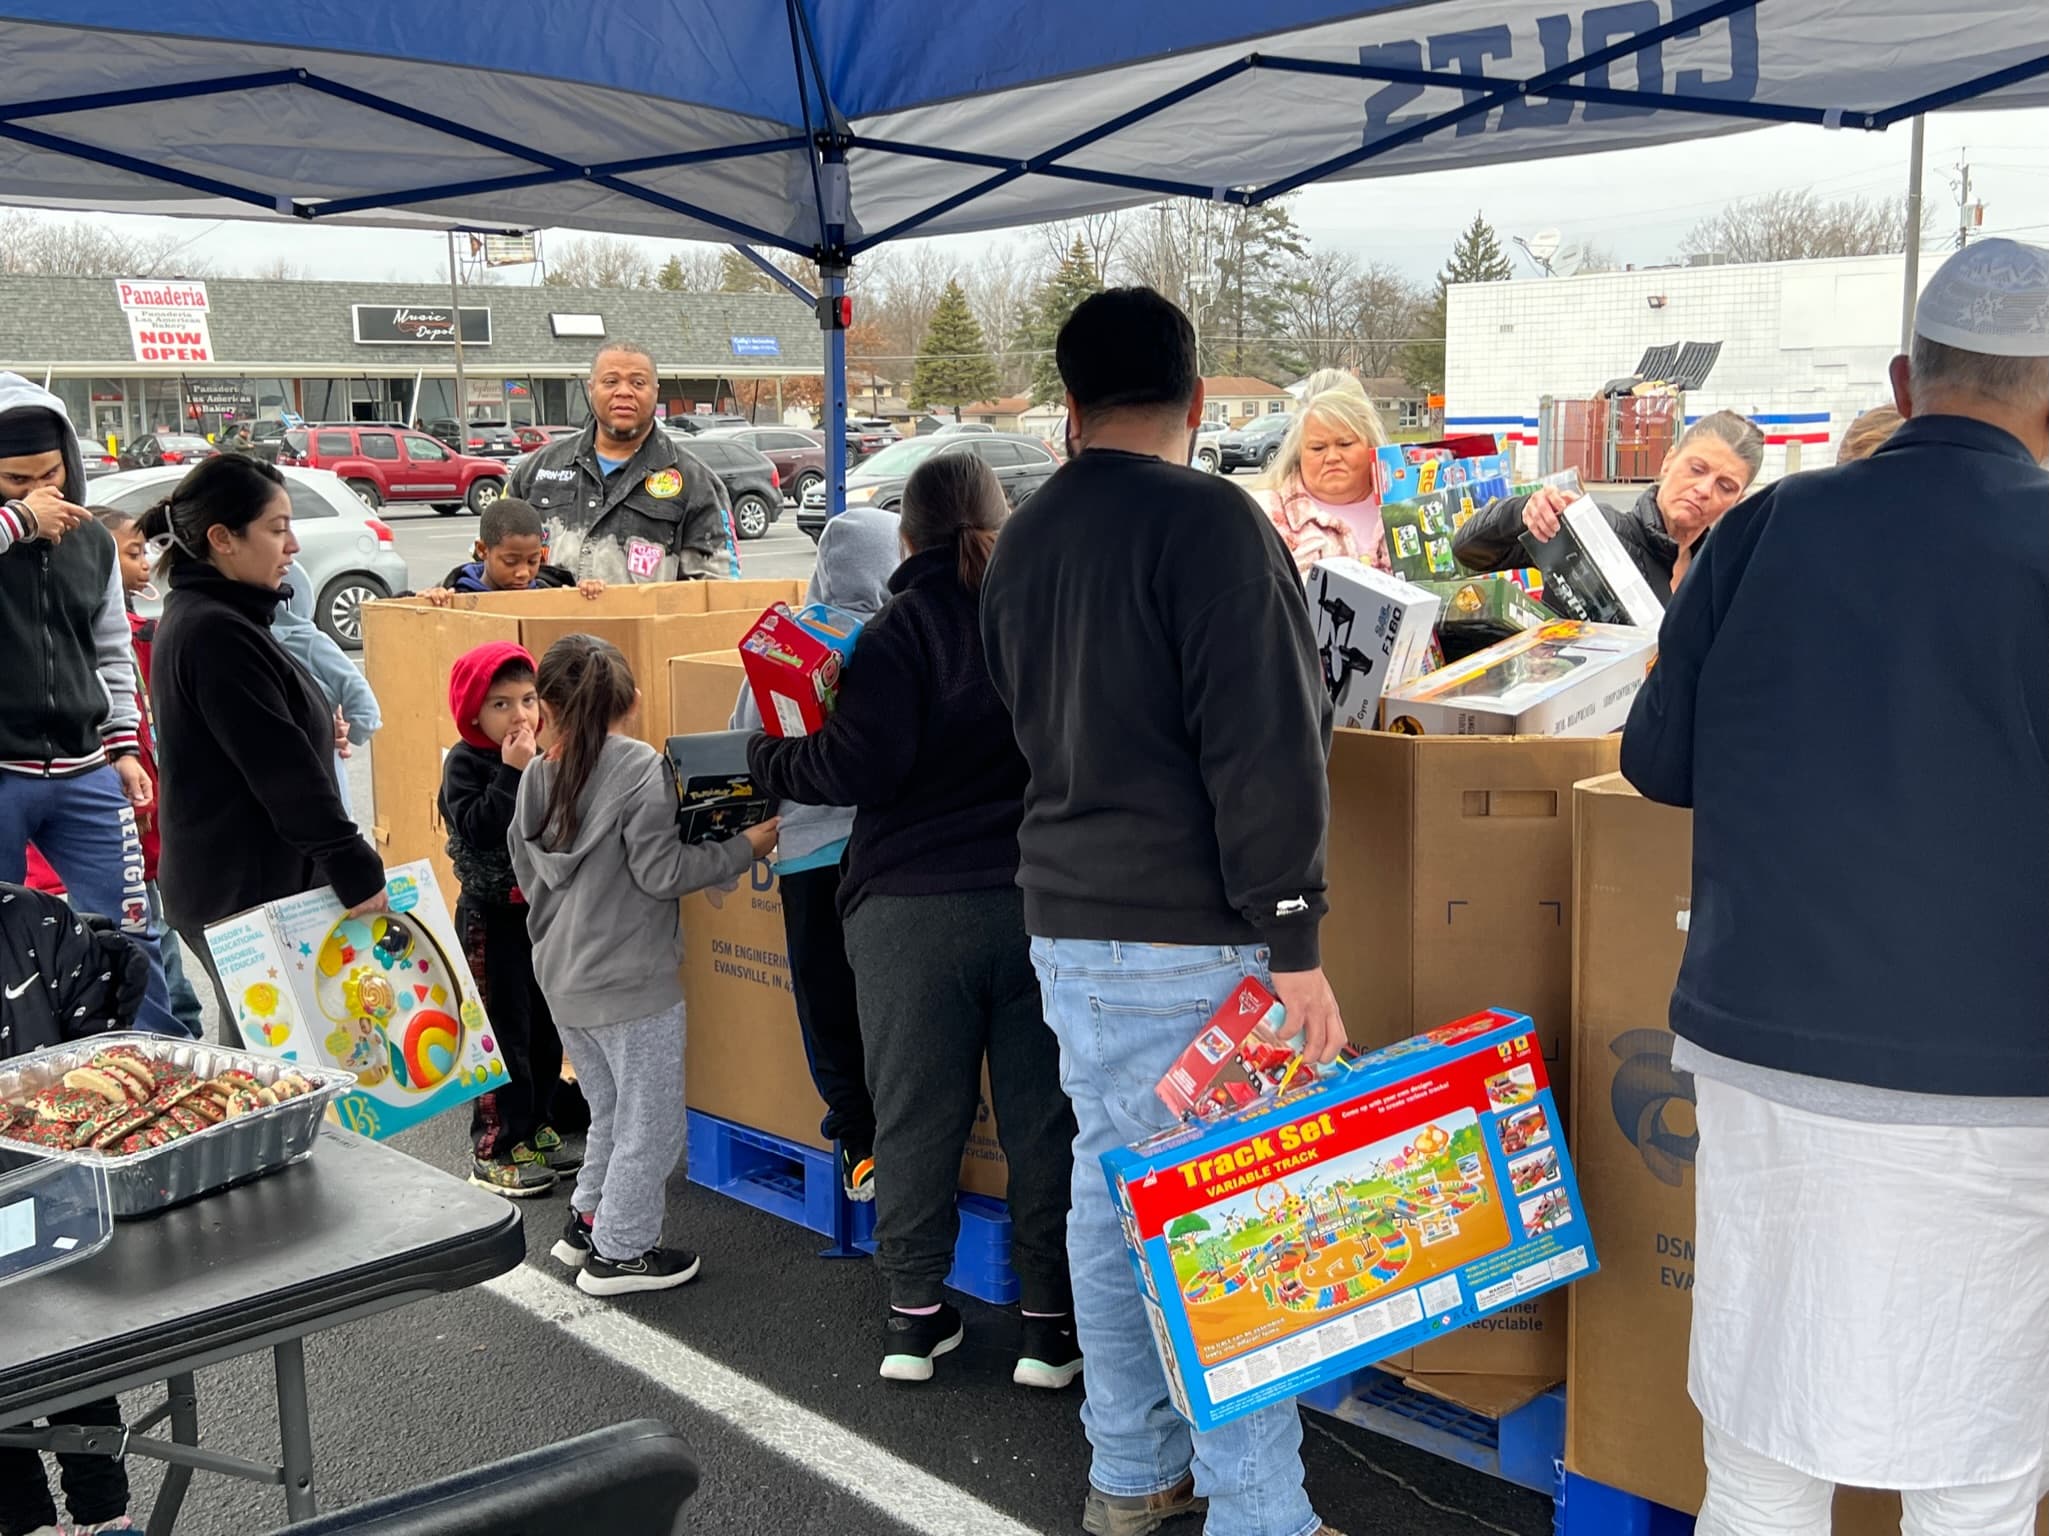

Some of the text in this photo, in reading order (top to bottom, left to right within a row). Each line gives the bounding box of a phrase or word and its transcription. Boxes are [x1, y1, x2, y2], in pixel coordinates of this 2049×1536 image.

[120, 285, 206, 306] Panaderia
[393, 309, 446, 325] Music
[139, 331, 202, 345] NOW
[416, 324, 455, 341] Depot
[142, 347, 208, 361] OPEN
[630, 553, 660, 577] FLY
[1382, 607, 1402, 656] F180
[1357, 699, 1369, 720] Gyro
[712, 940, 789, 970] DSM ENGINEERIN
[772, 974, 782, 988] IN
[1177, 1136, 1276, 1188] Track
[1278, 1113, 1336, 1151] Set
[1205, 1148, 1319, 1198] VARIABLE TRACK
